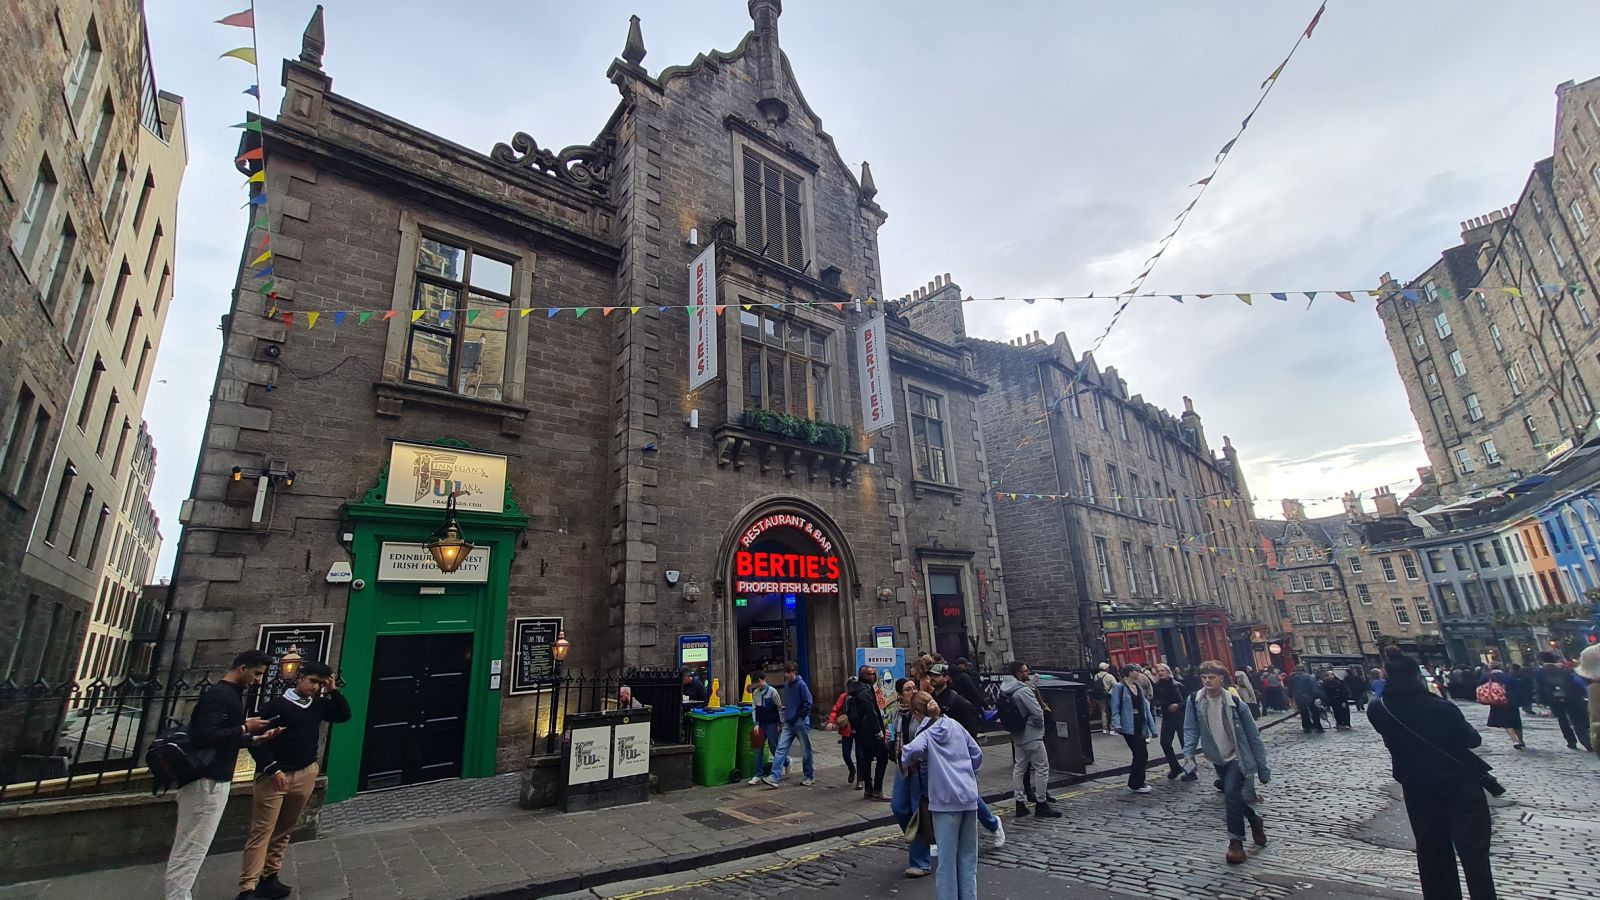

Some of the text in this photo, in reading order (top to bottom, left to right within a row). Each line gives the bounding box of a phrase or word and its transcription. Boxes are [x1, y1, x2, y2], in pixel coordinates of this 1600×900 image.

[864, 328, 880, 422] BERTIES
[741, 514, 832, 553] RESTAURANT & BAR
[389, 553, 434, 562] EDINBUR
[392, 562, 479, 571] IRISH HOSLITY
[736, 551, 840, 579] BERTIE'S
[736, 581, 839, 593] PROPER FISH & CHIPS
[943, 607, 960, 616] OPEN
